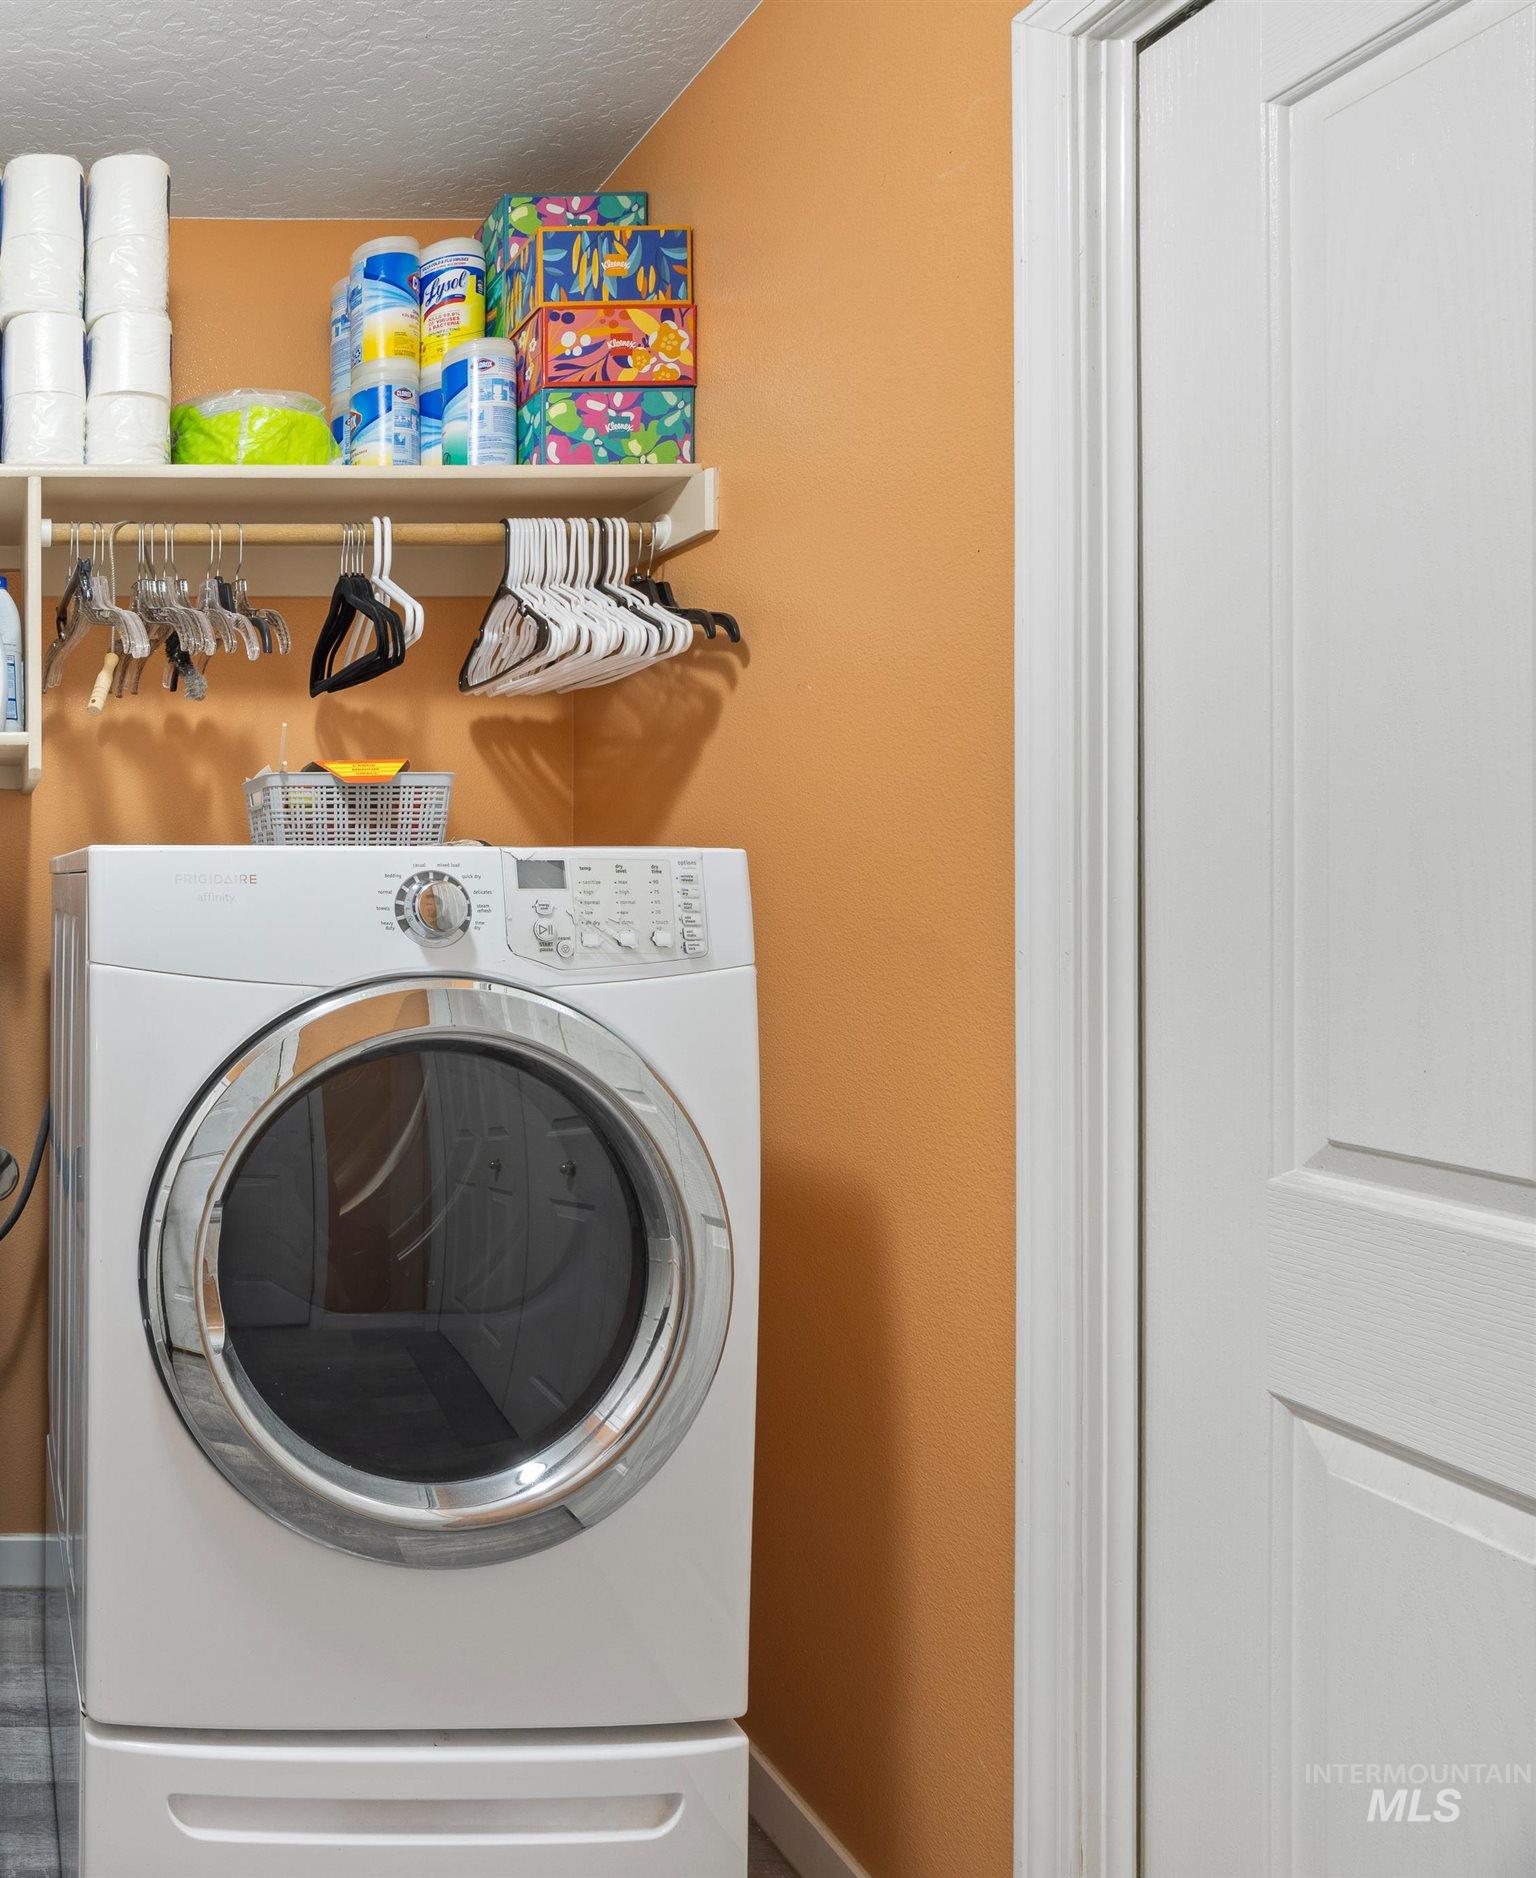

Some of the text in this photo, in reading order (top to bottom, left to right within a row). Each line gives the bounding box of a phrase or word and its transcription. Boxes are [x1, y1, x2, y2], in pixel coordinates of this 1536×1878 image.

[601, 261, 630, 270] Kleenex
[424, 270, 467, 307] Lysol
[607, 338, 637, 349] Kleenex
[605, 422, 634, 433] Kleenex
[175, 874, 257, 885] FRIGIDAIRE
[197, 892, 235, 904] affinity
